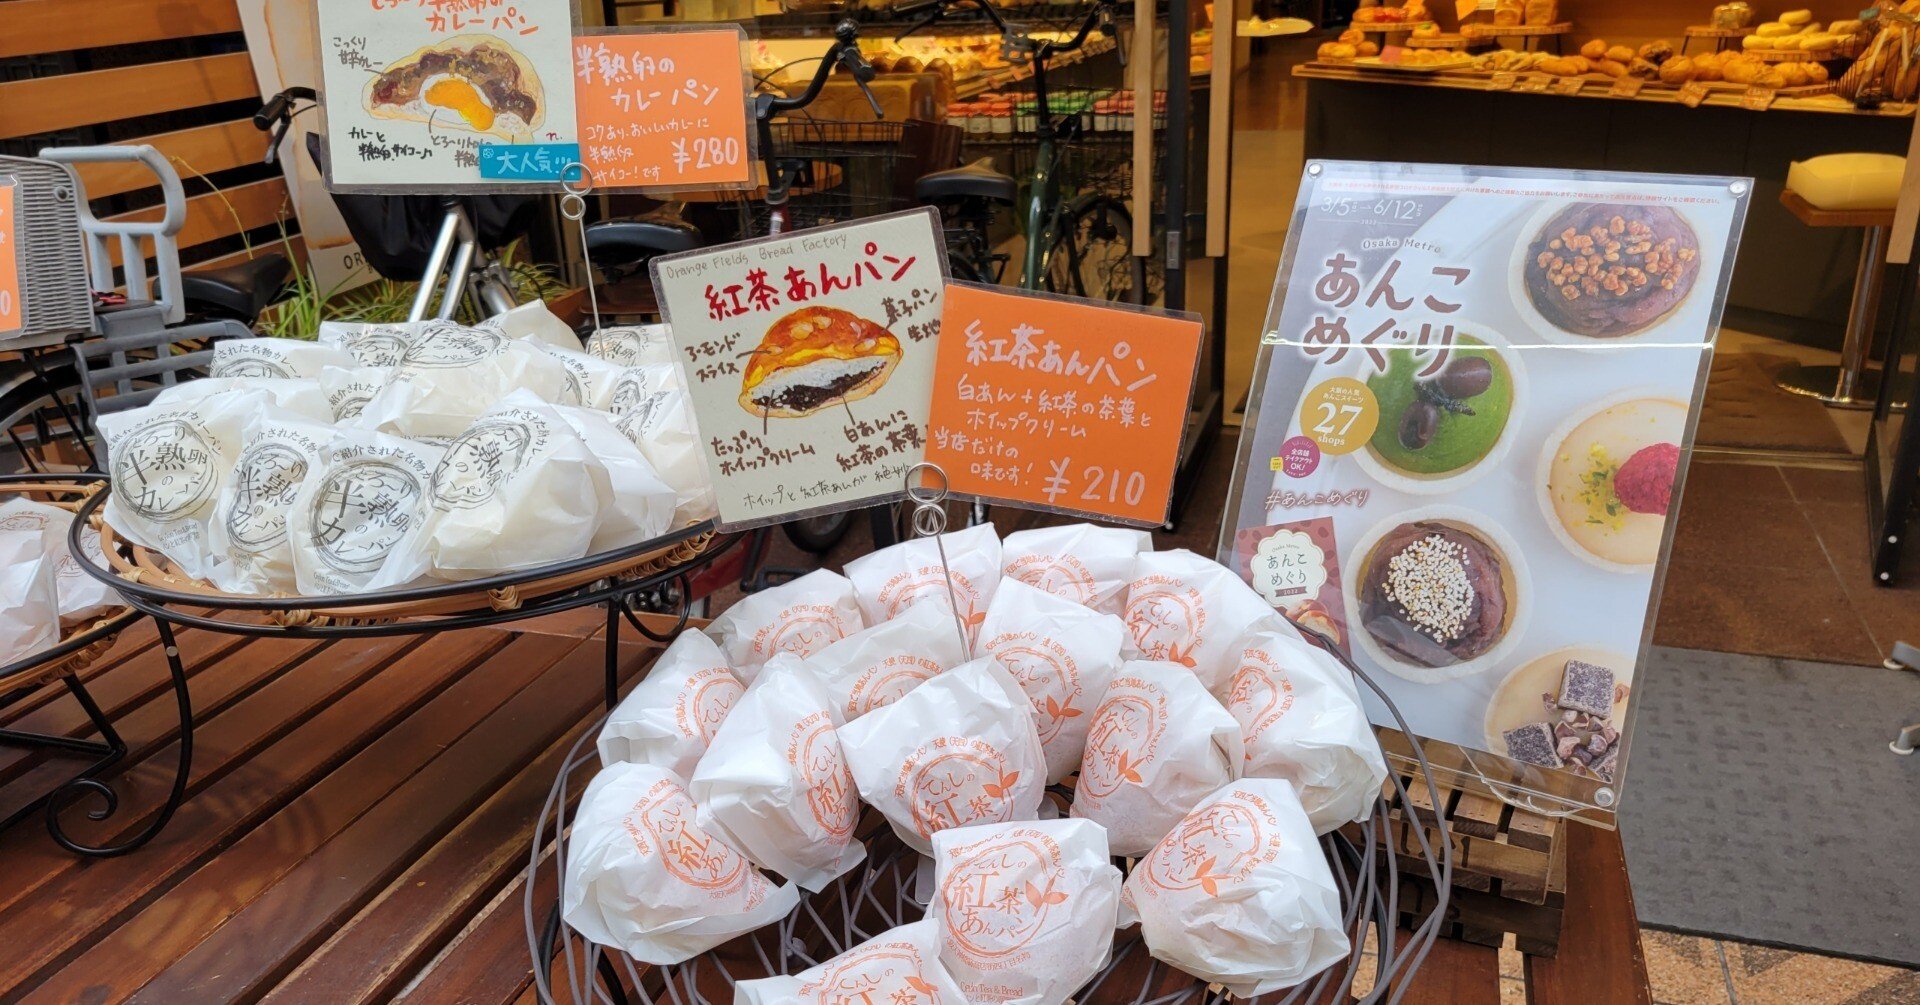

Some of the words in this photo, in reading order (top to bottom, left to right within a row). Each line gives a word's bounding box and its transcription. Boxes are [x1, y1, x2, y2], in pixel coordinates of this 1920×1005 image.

[426, 7, 539, 35] カレーパン
[333, 36, 367, 48] こっくり
[576, 42, 675, 86] 半熟卵の
[611, 78, 719, 113] カレーパン
[348, 126, 386, 142] カレーと
[589, 145, 634, 165] 半熟卵
[1320, 196, 1352, 217] 3/5
[1373, 199, 1416, 220] 6/12
[666, 261, 709, 281] Orange
[712, 254, 749, 270] Fields
[758, 242, 794, 261] Bread
[802, 232, 848, 252] Factory
[1362, 238, 1399, 249] Osaka
[1404, 238, 1442, 254] Metro
[703, 241, 917, 322] 紅茶あんパン
[1314, 253, 1472, 314] あんこ
[881, 288, 938, 321] 菓子パン
[907, 318, 942, 343] 生地
[684, 331, 741, 362] アーモンド
[963, 318, 1158, 392] 紅茶あんパン
[1302, 316, 1455, 378] めぐり
[695, 361, 741, 382] スライス
[843, 410, 909, 443] 白あんに
[966, 408, 1087, 438] ホイップクリーム
[1312, 402, 1364, 436] 27
[711, 429, 763, 457] たっぷり
[935, 426, 1019, 459] 当店だけの
[1317, 434, 1345, 446] shops
[121, 442, 208, 486] 半熟卵
[718, 443, 817, 477] ホイップクリーム
[161, 474, 174, 486] の
[253, 504, 264, 518] の
[355, 524, 368, 534] の
[1266, 553, 1307, 570] あんこ
[1271, 569, 1307, 586] めぐり
[920, 773, 976, 796] てんしの
[973, 853, 1028, 870] てんしの
[952, 870, 1025, 915] 紅茶
[959, 907, 1035, 939] あんパン
[1001, 985, 1024, 998] Bread
